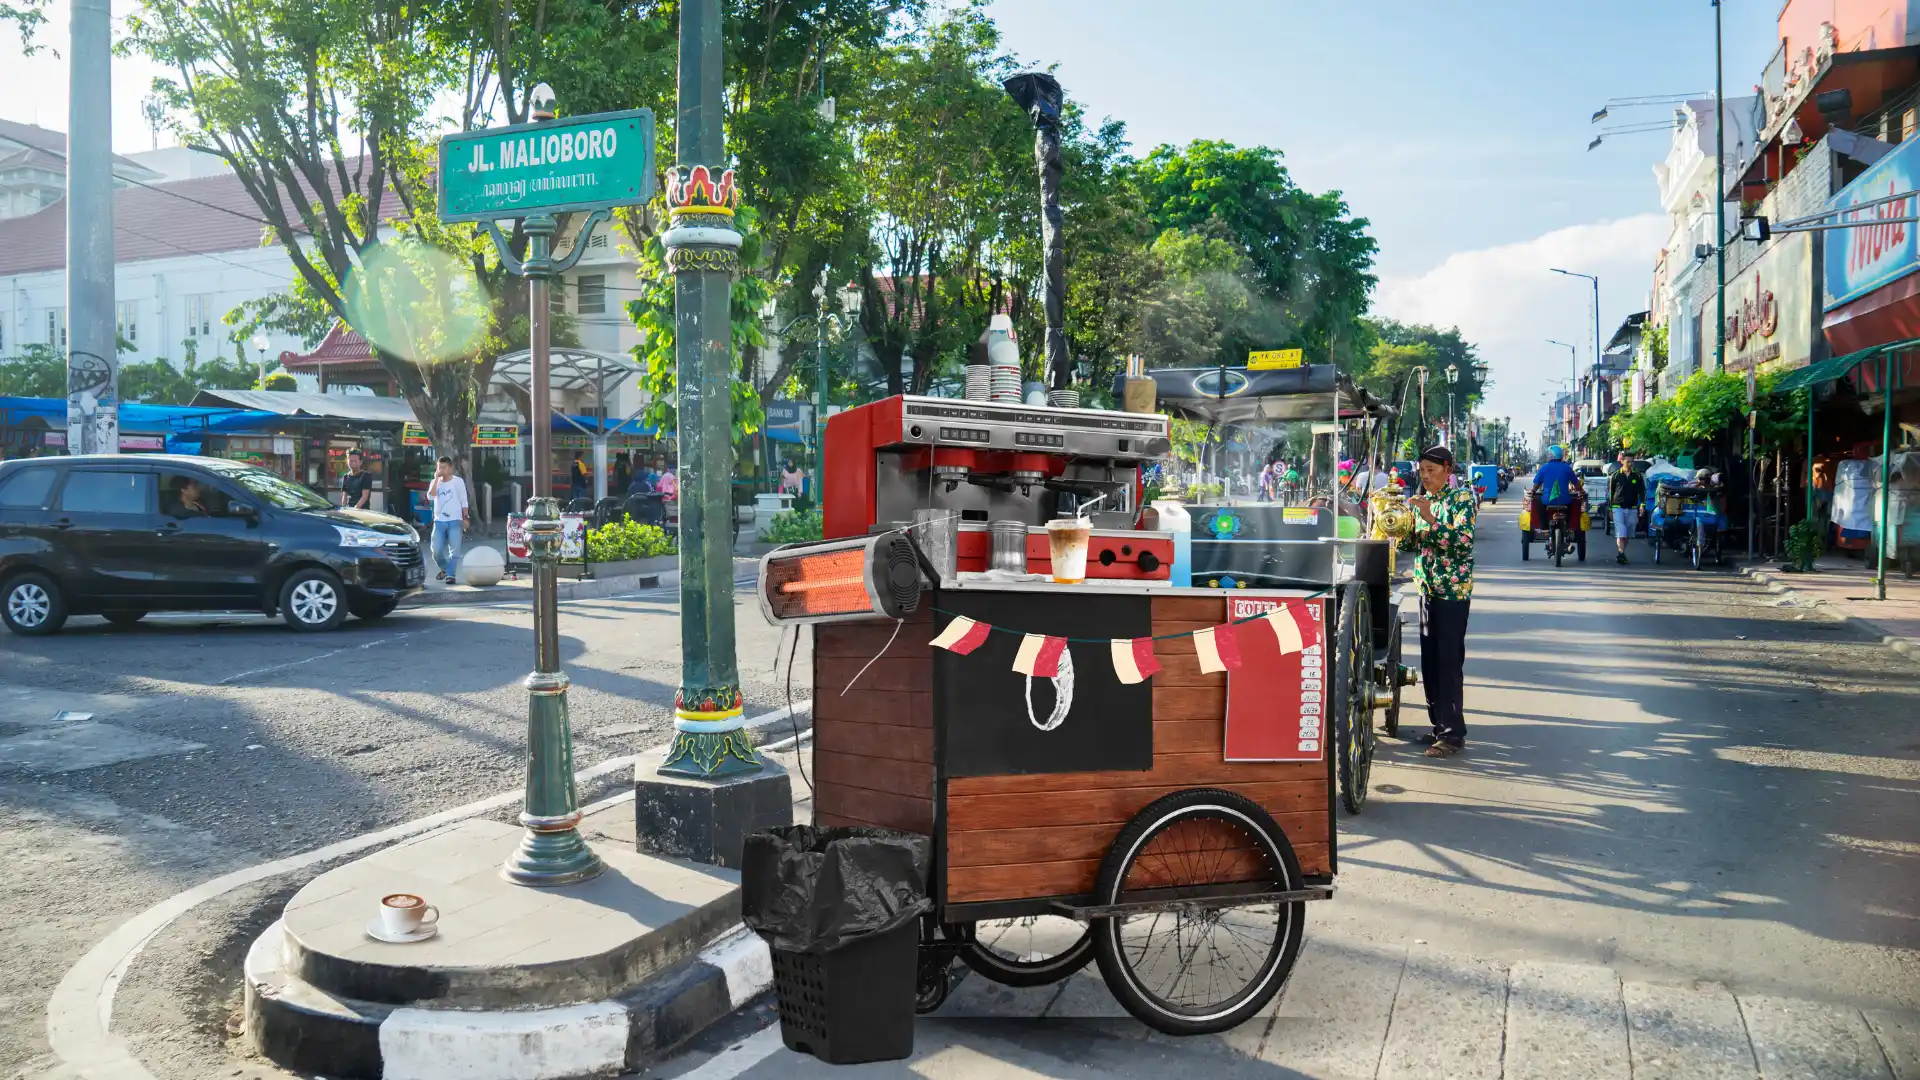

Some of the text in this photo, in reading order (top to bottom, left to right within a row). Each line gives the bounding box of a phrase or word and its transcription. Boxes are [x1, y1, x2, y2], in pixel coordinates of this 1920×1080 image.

[468, 128, 617, 173] JL. MALIOBORO
[770, 408, 784, 417] BANK
